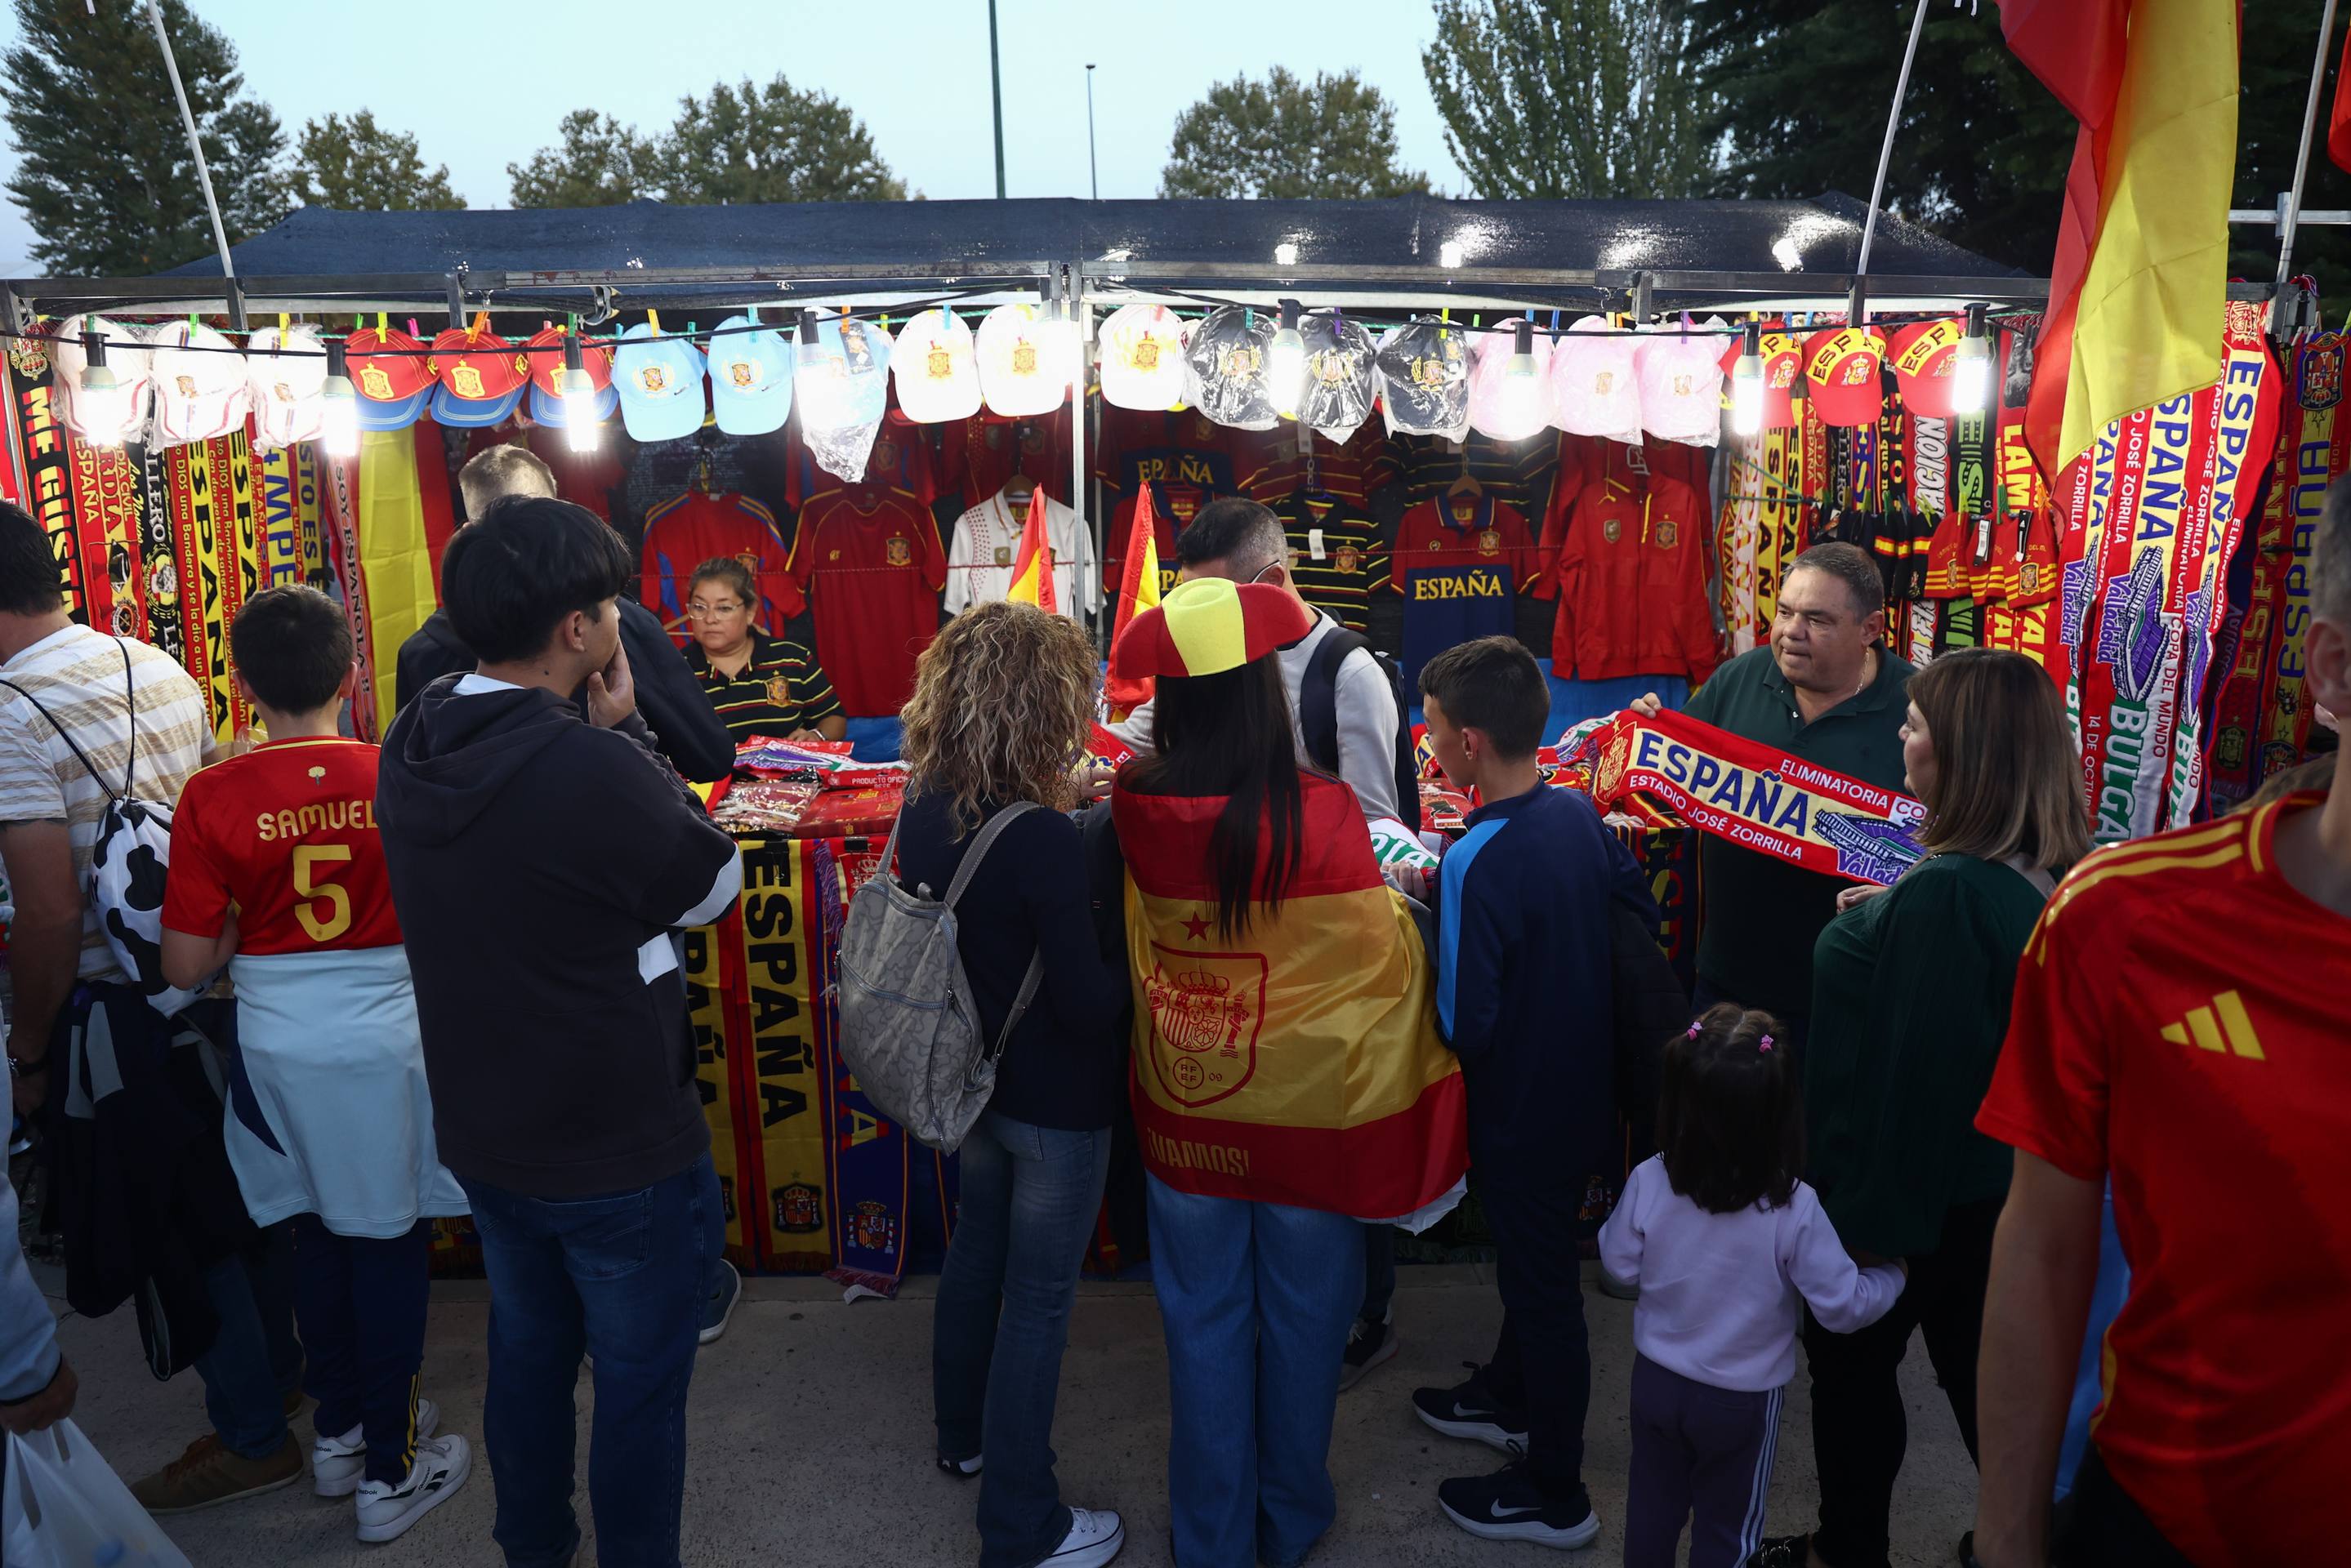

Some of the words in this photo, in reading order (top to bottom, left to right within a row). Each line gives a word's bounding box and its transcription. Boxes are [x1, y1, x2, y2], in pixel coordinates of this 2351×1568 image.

[2126, 428, 2144, 469] JOSÉ
[2137, 394, 2191, 541] SPAÑA
[2203, 435, 2215, 479] JOSÉ
[2208, 361, 2264, 555] ESPAÑA
[74, 436, 99, 523] ESPAÑA
[128, 457, 141, 489] Los
[176, 460, 188, 490] DIOS
[217, 460, 230, 489] DIOS
[299, 443, 315, 506] STO
[2090, 420, 2122, 528] PAÑA
[120, 483, 132, 521] CIVIL
[180, 496, 189, 520] una
[221, 494, 229, 517] una
[254, 463, 265, 534] ESPAÑA
[2070, 466, 2088, 531] ZORRILLA
[2114, 474, 2136, 544] ZORRILLA
[2192, 485, 2210, 558] ZORRILLA
[183, 524, 194, 578] Bandera
[217, 539, 224, 553] de
[303, 520, 318, 559] ES
[1758, 428, 1781, 637] SPAÑA
[186, 581, 196, 592] y
[336, 466, 350, 516] SOY
[343, 527, 366, 667] ESPAÑOLA
[1414, 569, 1504, 600] ESPAÑA
[189, 592, 197, 604] se
[190, 608, 200, 620] la
[2061, 560, 2086, 645] Valladolid
[2096, 573, 2131, 663] Valladolid
[192, 623, 201, 643] dió
[2166, 617, 2182, 660] COPA
[195, 657, 203, 673] un
[2161, 670, 2177, 694] DEL
[2086, 733, 2099, 751] DE
[2088, 715, 2101, 728] 14
[2152, 700, 2173, 758] MUNDO
[852, 777, 886, 785] PRODUCTO
[1636, 731, 1809, 838] ESPAÑA
[1780, 759, 1889, 808] ELIMINATORIA
[1896, 801, 1925, 820] CO
[2094, 704, 2148, 840] BULGA
[257, 800, 378, 842] SAMUEL
[1630, 774, 1687, 811] ESTADIO
[1688, 807, 1729, 831] JOSÉ
[1729, 823, 1803, 861] ZORRILLA
[1837, 849, 1903, 886] Vallad
[292, 844, 352, 942] 5
[743, 846, 815, 1129] ESPAÑA
[684, 931, 725, 1107] PAÑA
[1147, 1126, 1249, 1177] ¡VAMOS!
